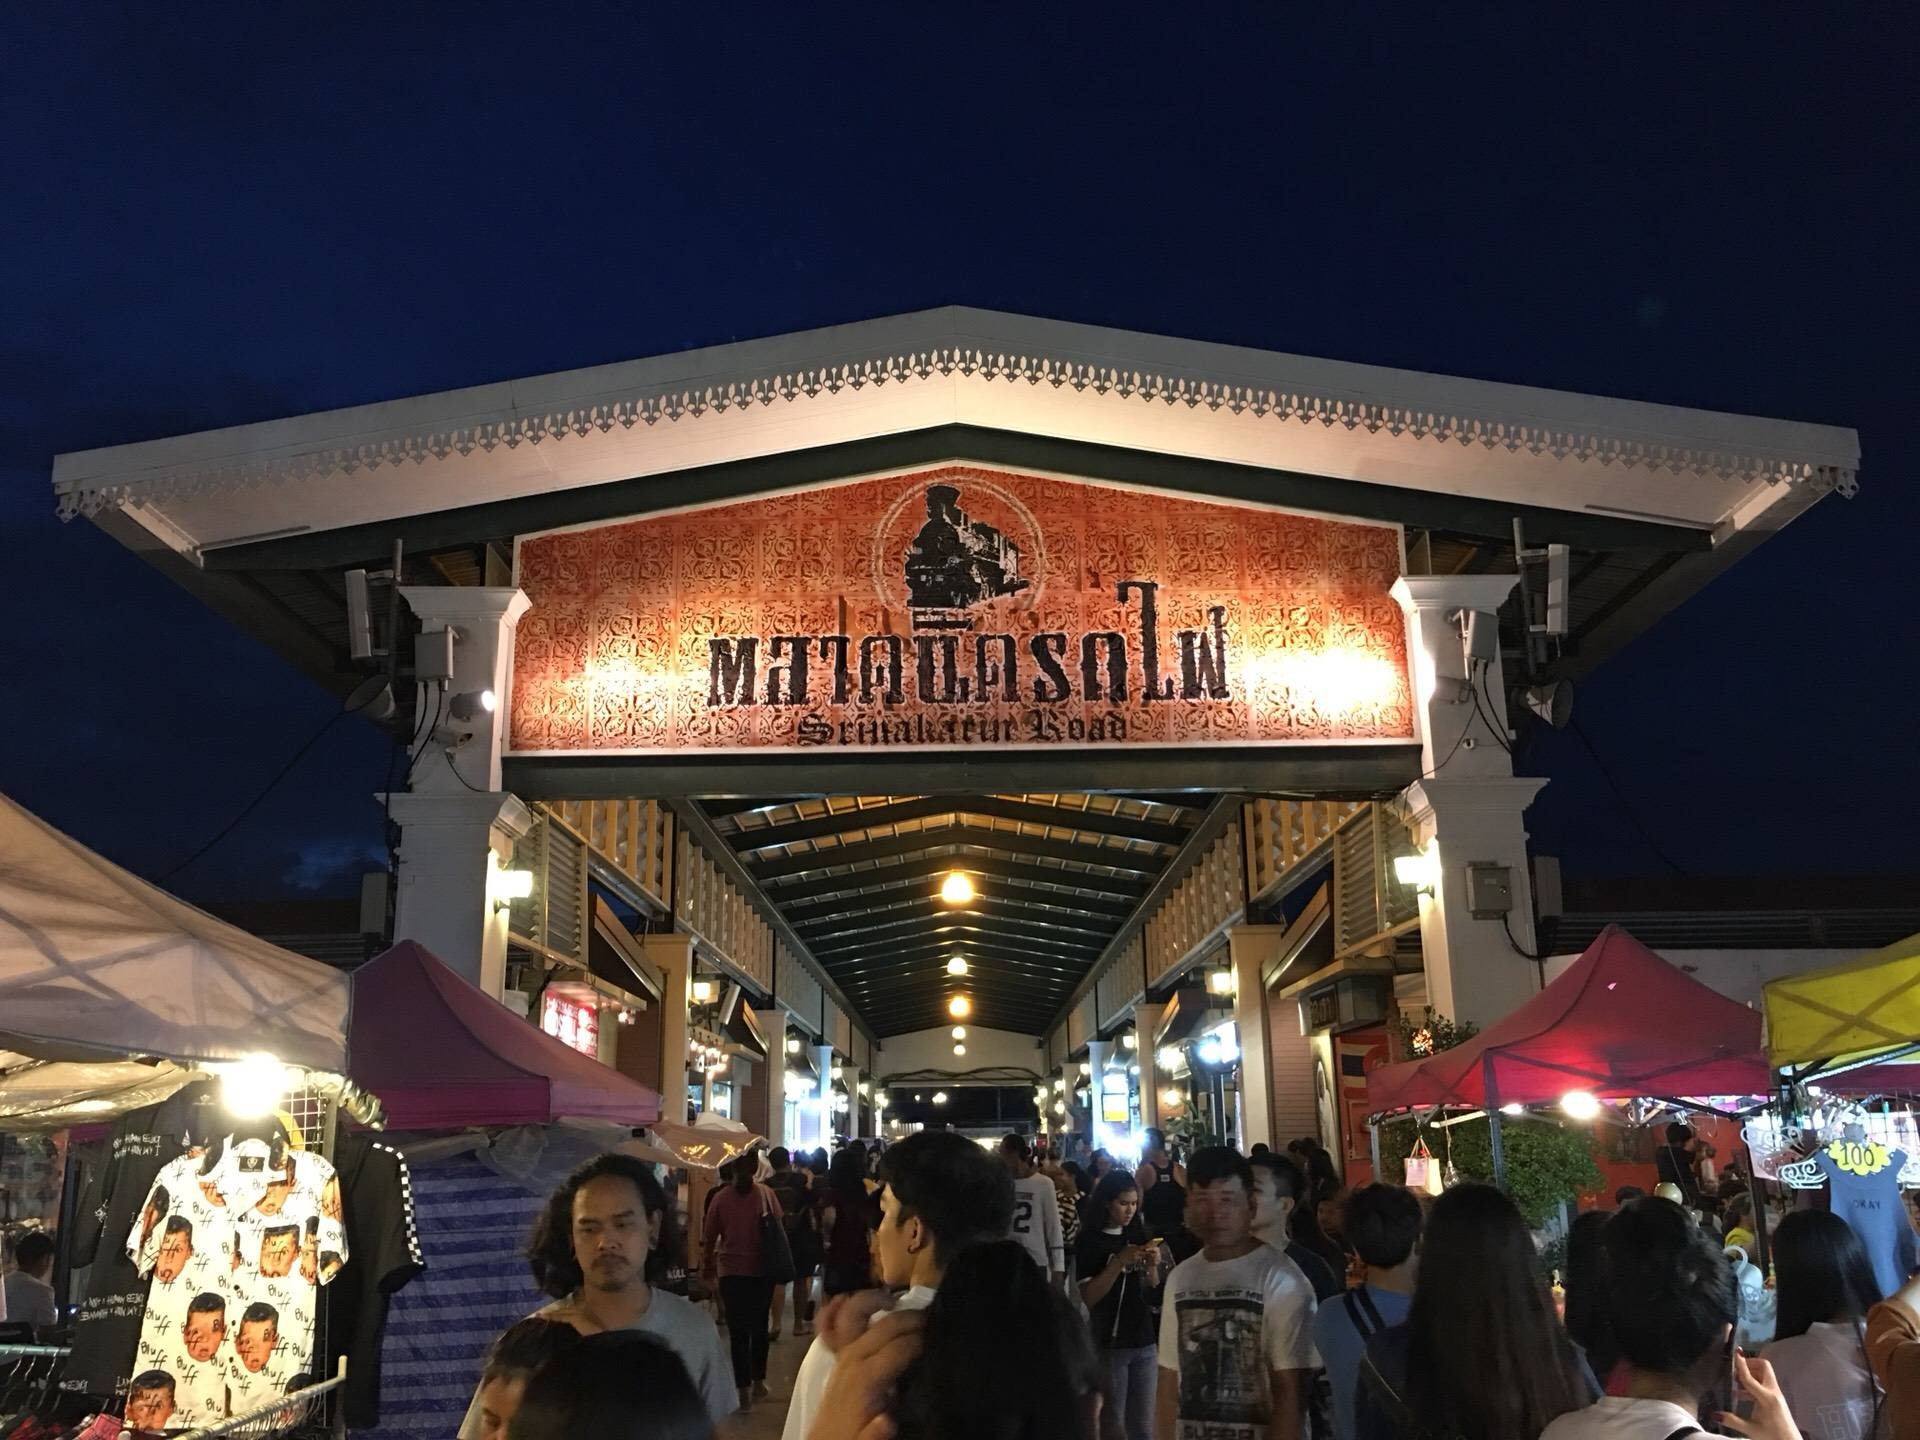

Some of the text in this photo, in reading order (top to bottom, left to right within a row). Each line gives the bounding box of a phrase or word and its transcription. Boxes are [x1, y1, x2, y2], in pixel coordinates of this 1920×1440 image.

[1028, 707, 1128, 744] Road
[1840, 1146, 1875, 1167] 100
[146, 1307, 172, 1336] Bluff
[141, 1341, 168, 1370] Bluff
